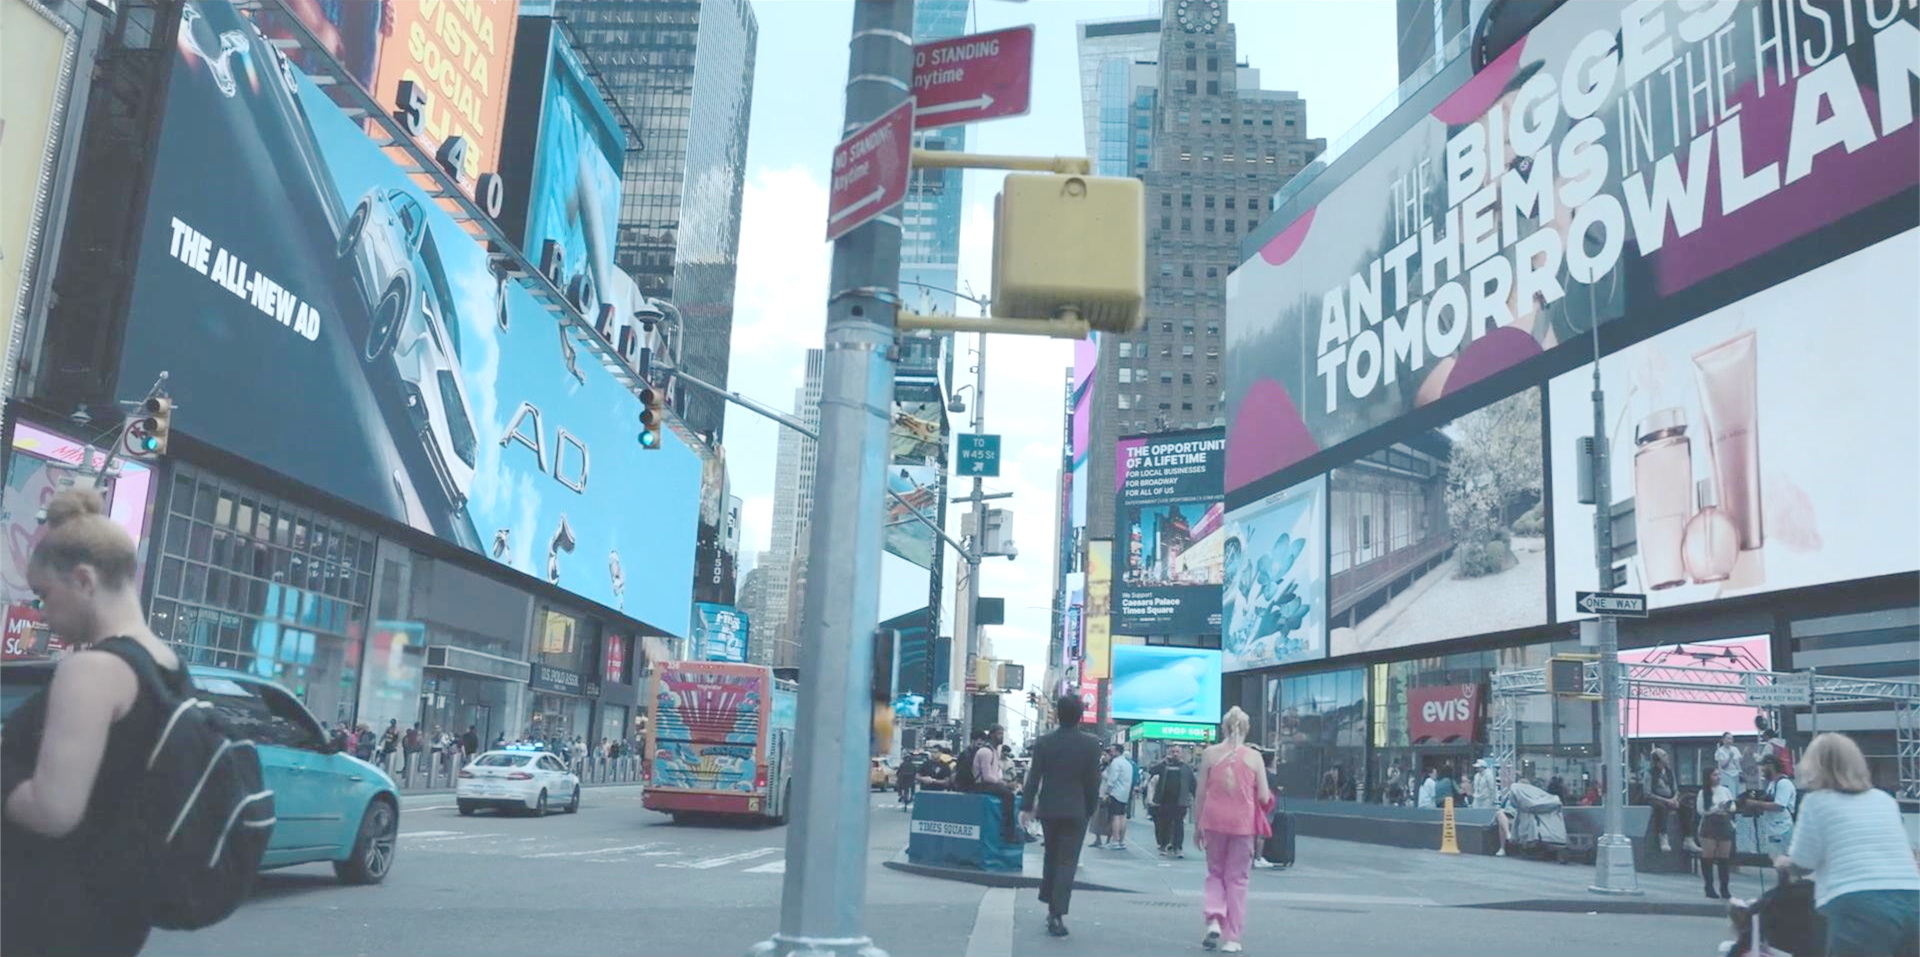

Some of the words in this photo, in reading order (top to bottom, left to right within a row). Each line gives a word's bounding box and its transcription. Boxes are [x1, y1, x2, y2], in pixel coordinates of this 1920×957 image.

[419, 0, 488, 98] VISTA
[931, 39, 1000, 66] STANDING
[408, 21, 484, 137] SOCIAL
[914, 68, 965, 91] nytime
[834, 150, 849, 173] NO
[849, 122, 894, 162] STANDING
[833, 161, 870, 192] Anytime
[1317, 117, 1609, 357] ANTHEMS
[1618, 78, 1654, 178] IN
[1661, 21, 1742, 147] THE
[1391, 158, 1434, 244] THE
[170, 216, 212, 275] THE
[210, 247, 297, 327] ALL-NEW
[293, 301, 321, 341] AD
[972, 438, 985, 448] TO
[1126, 446, 1150, 458] THE
[1151, 439, 1225, 455] OPPORTUNIT
[962, 450, 972, 459] W
[972, 450, 984, 459] 45
[985, 450, 995, 460] St
[1126, 458, 1142, 469] OF
[1143, 457, 1152, 468] A
[1154, 452, 1207, 467] LIFETIME
[1125, 470, 1140, 479] FOR
[1140, 468, 1163, 478] LOCAL
[1163, 465, 1206, 476] BUSINESSES
[1125, 479, 1139, 488] FOR
[1140, 477, 1178, 487] BROADWAY
[1125, 489, 1139, 497] FOR
[1140, 488, 1152, 496] ALL
[1153, 487, 1163, 495] OF
[1164, 486, 1174, 494] US
[712, 550, 723, 584] 1500
[1121, 598, 1153, 607] Caesars
[1154, 597, 1180, 606] Palace
[1122, 606, 1146, 615] Times
[1146, 606, 1174, 616] Square
[1586, 598, 1607, 608] ONE
[1616, 600, 1637, 609] WAY
[919, 821, 942, 833] TIMES
[943, 824, 974, 836] SQUARE
